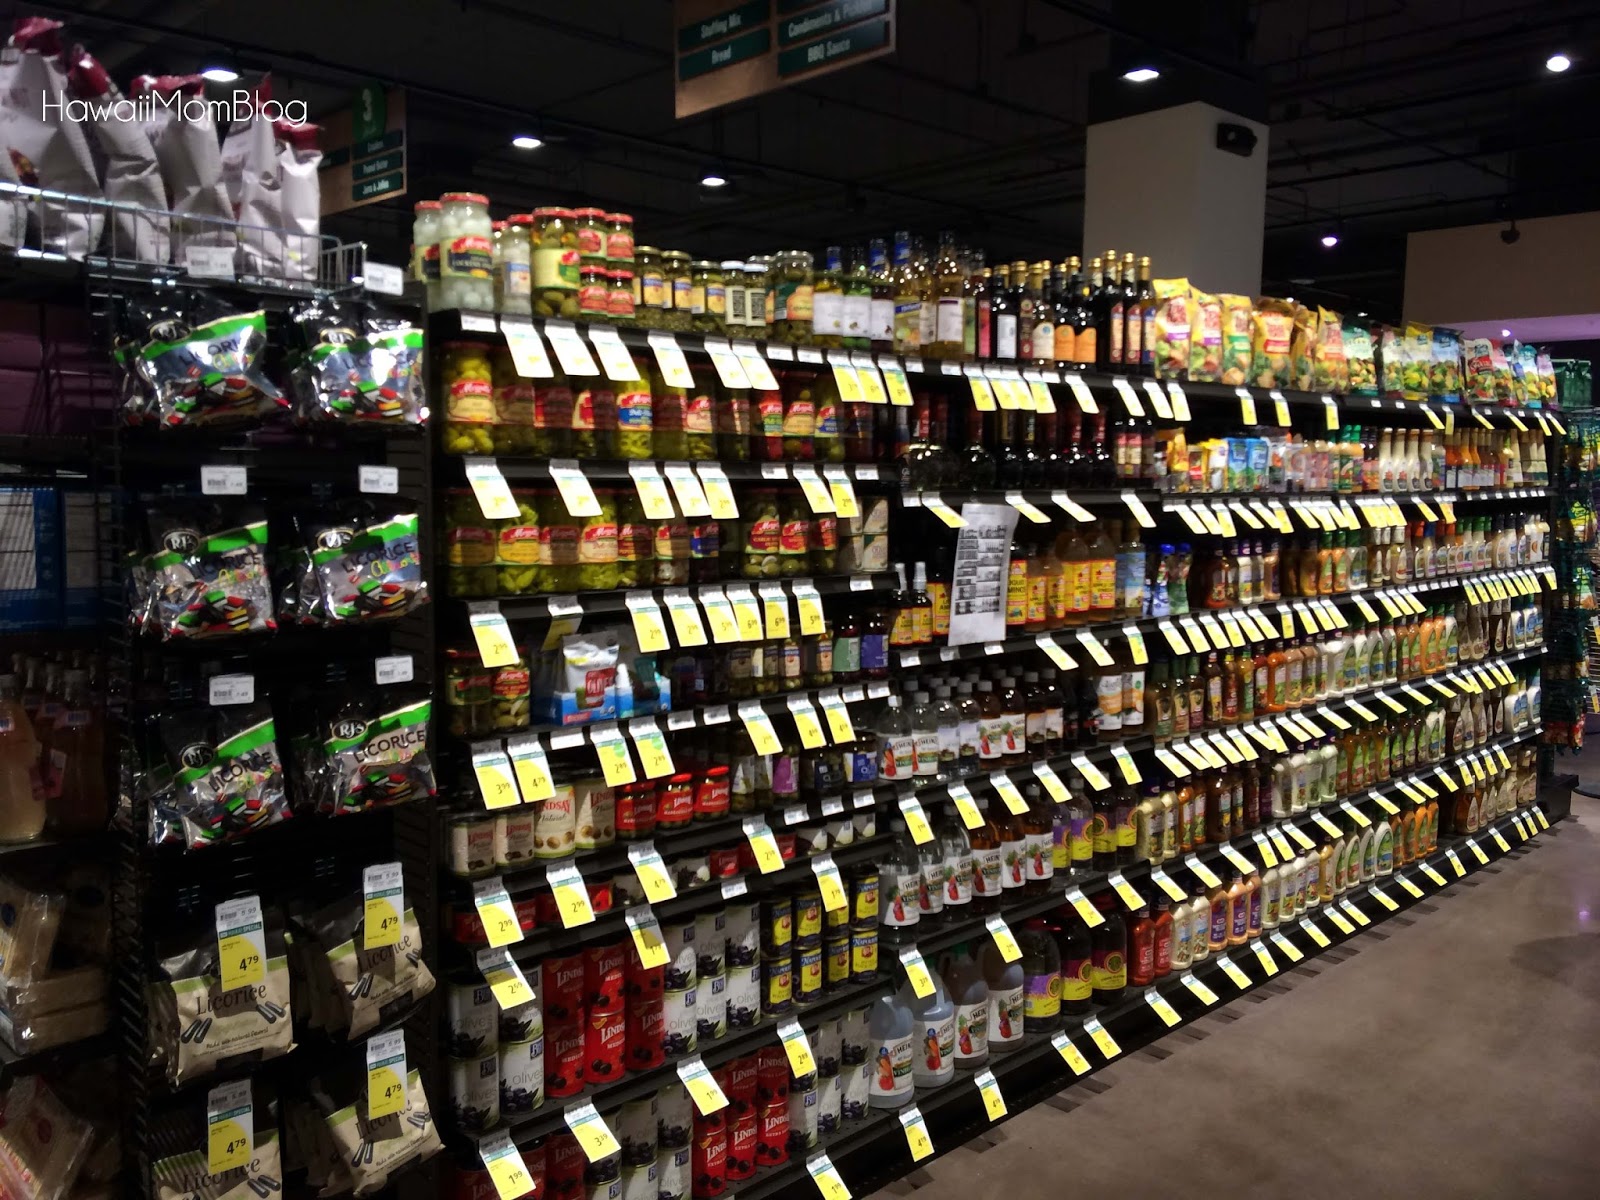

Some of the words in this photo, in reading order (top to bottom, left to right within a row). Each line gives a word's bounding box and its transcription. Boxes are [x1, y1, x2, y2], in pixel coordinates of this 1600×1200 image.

[362, 88, 373, 122] 3
[352, 729, 426, 764] LICORICE
[196, 984, 268, 1016] Licorice
